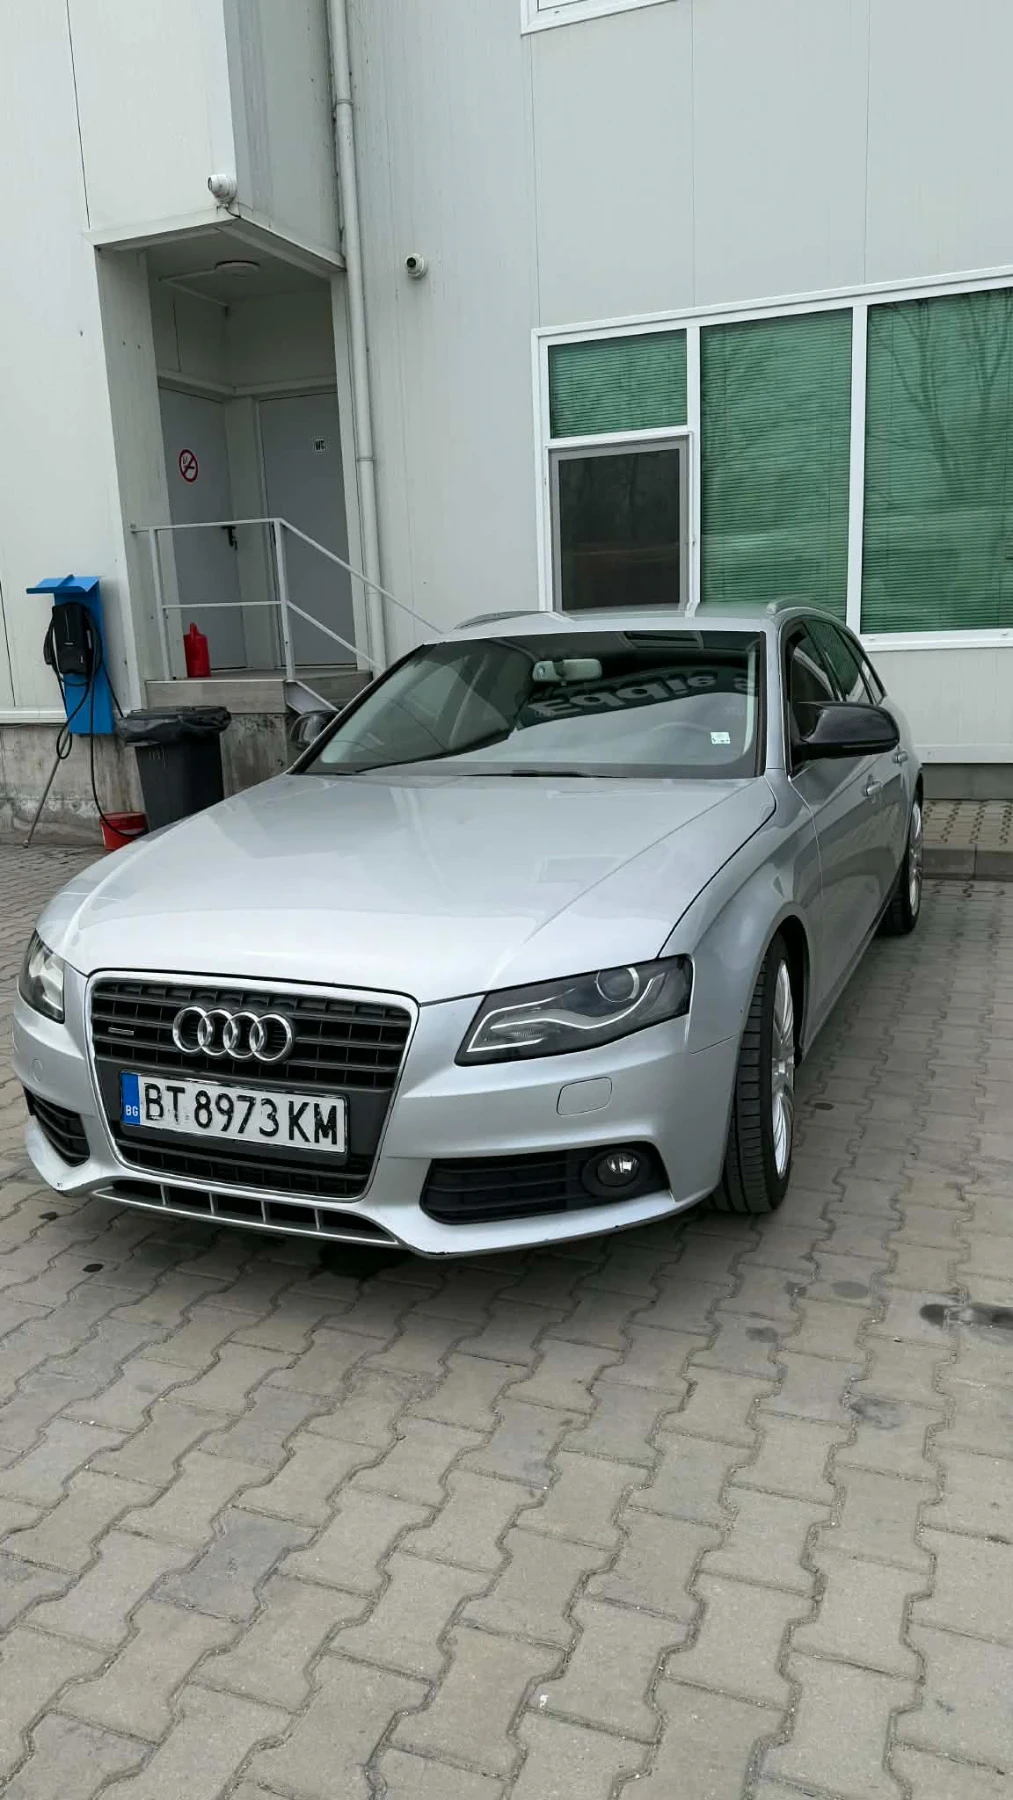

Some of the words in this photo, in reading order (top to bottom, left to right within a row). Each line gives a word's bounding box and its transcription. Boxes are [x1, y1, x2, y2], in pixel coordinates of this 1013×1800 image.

[125, 1104, 139, 1117] BG
[144, 1082, 186, 1123] BT
[194, 1090, 280, 1138] 8973
[288, 1100, 338, 1146] KM
